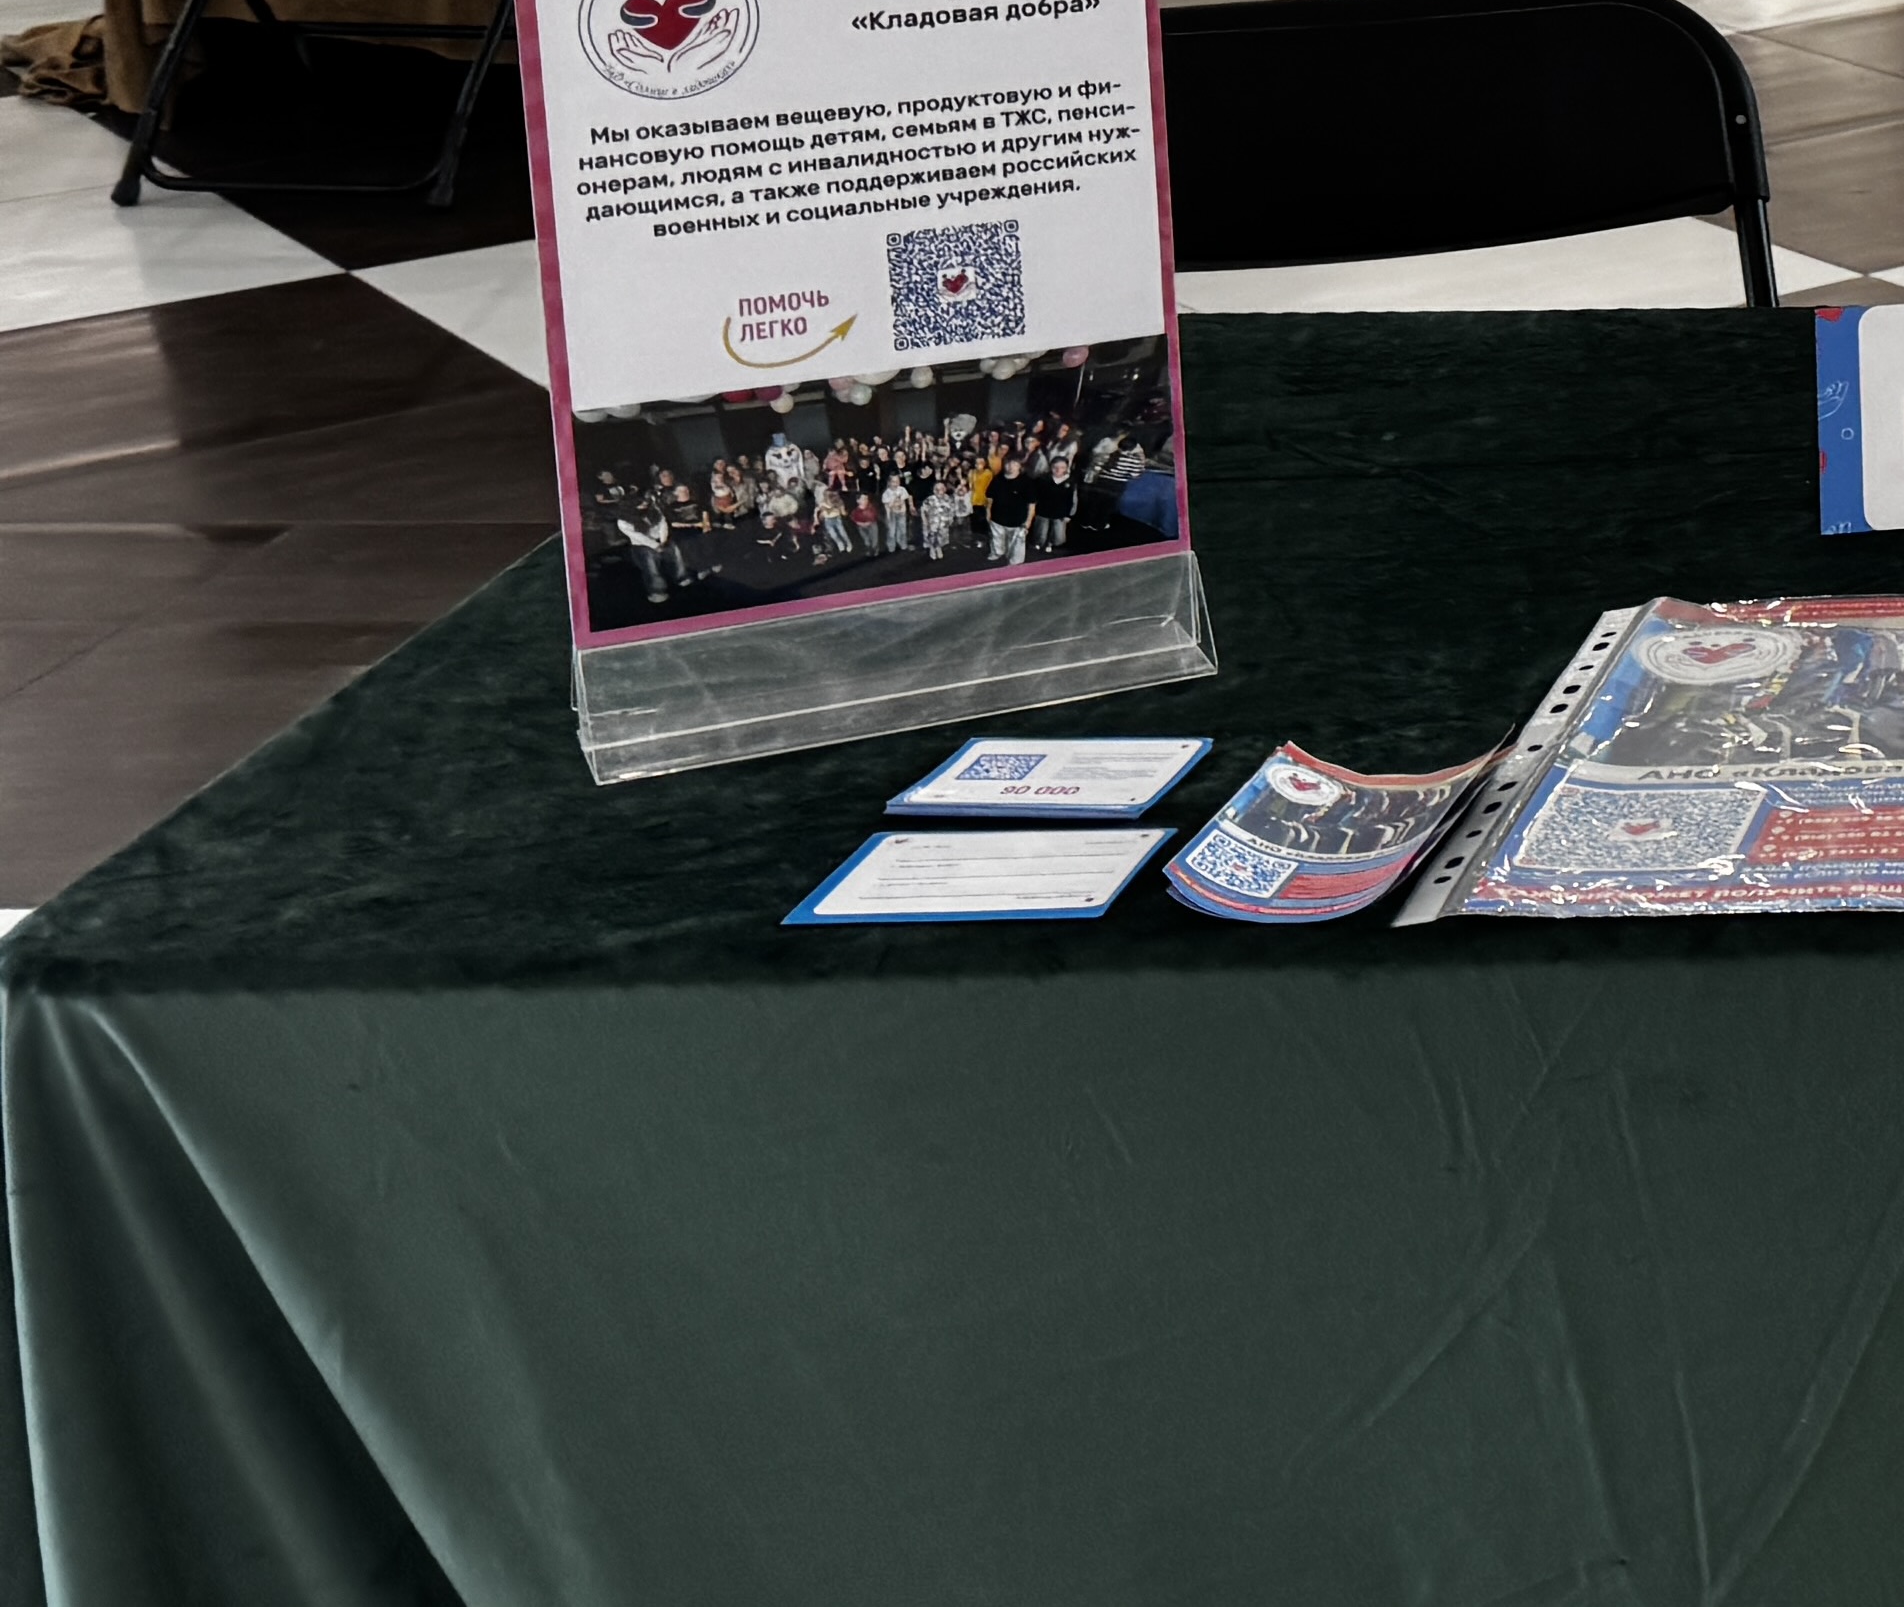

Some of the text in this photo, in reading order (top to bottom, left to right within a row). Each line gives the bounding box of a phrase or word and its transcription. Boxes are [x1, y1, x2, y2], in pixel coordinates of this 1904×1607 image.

[851, 4, 999, 32] «Кладовая
[578, 103, 1136, 171] нансовую помощь детям, семьям в ТЖС, пенси-
[590, 80, 1121, 145] Мы оказываем вещевую, продуктовую и фи-
[577, 125, 1141, 195] онерам, людям с инвалидностью и другим нуж-
[585, 148, 1137, 222] дающимся, а также поддерживаем российских
[653, 177, 1081, 237] военных и социальные учреждения.
[738, 288, 830, 317] ПОМОЧЬ
[739, 316, 808, 343] ЛЕГКО
